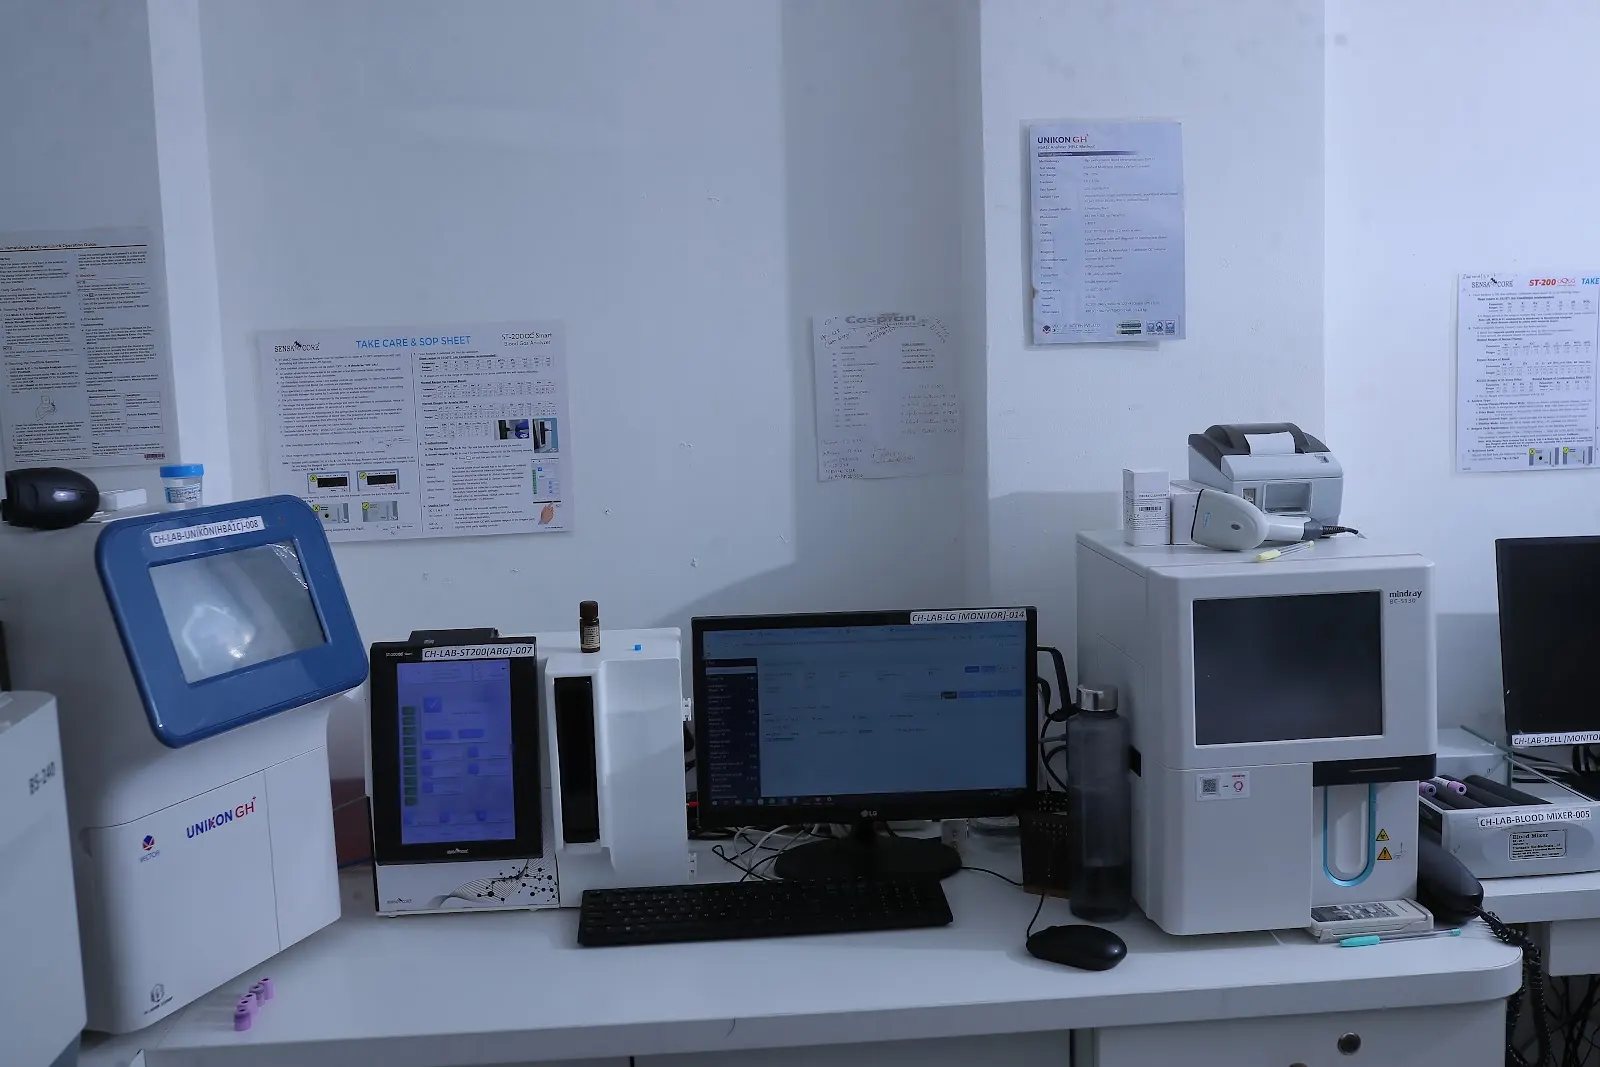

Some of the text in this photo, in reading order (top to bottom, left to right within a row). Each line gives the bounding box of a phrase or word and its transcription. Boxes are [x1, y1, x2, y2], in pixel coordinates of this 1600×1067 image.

[1037, 136, 1071, 144] UNIKON
[1529, 278, 1557, 287] ST-200
[1581, 277, 1600, 285] TAKE
[356, 336, 471, 349] TAKE CARE & SOP SHEET
[153, 519, 259, 545] CH-LAB-UNIKON(HBA1C)-008
[1389, 590, 1422, 598] mindray
[912, 611, 1025, 622] CH-LAB-LG [MONITOR]-014
[424, 646, 533, 658] CH-LAB-ST200(ABG)-007
[1514, 736, 1562, 744] CH-LAB-DELL
[186, 809, 233, 839] UNIKON
[1480, 810, 1590, 827] CH-LAB-BLOOD MIXER-005
